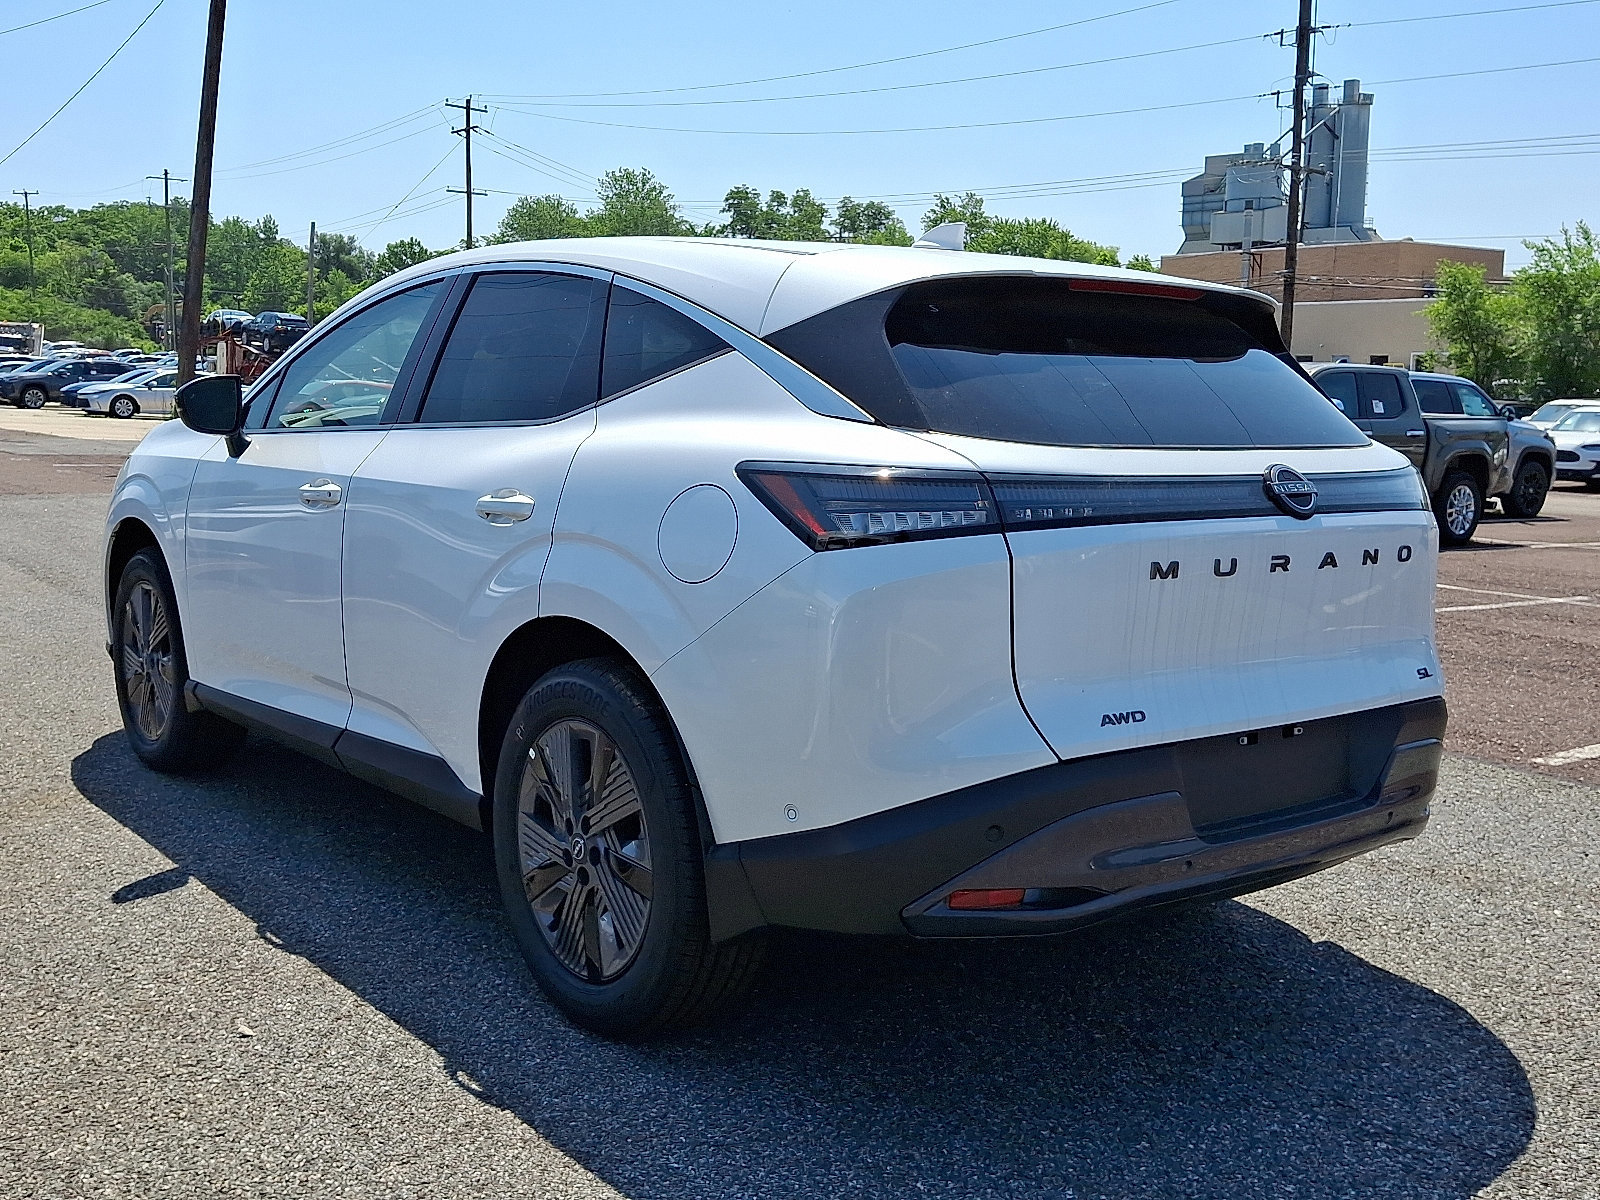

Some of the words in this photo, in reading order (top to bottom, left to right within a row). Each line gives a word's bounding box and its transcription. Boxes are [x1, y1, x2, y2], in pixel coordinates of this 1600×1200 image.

[1149, 545, 1413, 580] MURANO
[1416, 667, 1433, 680] SL
[1100, 710, 1146, 727] AWD
